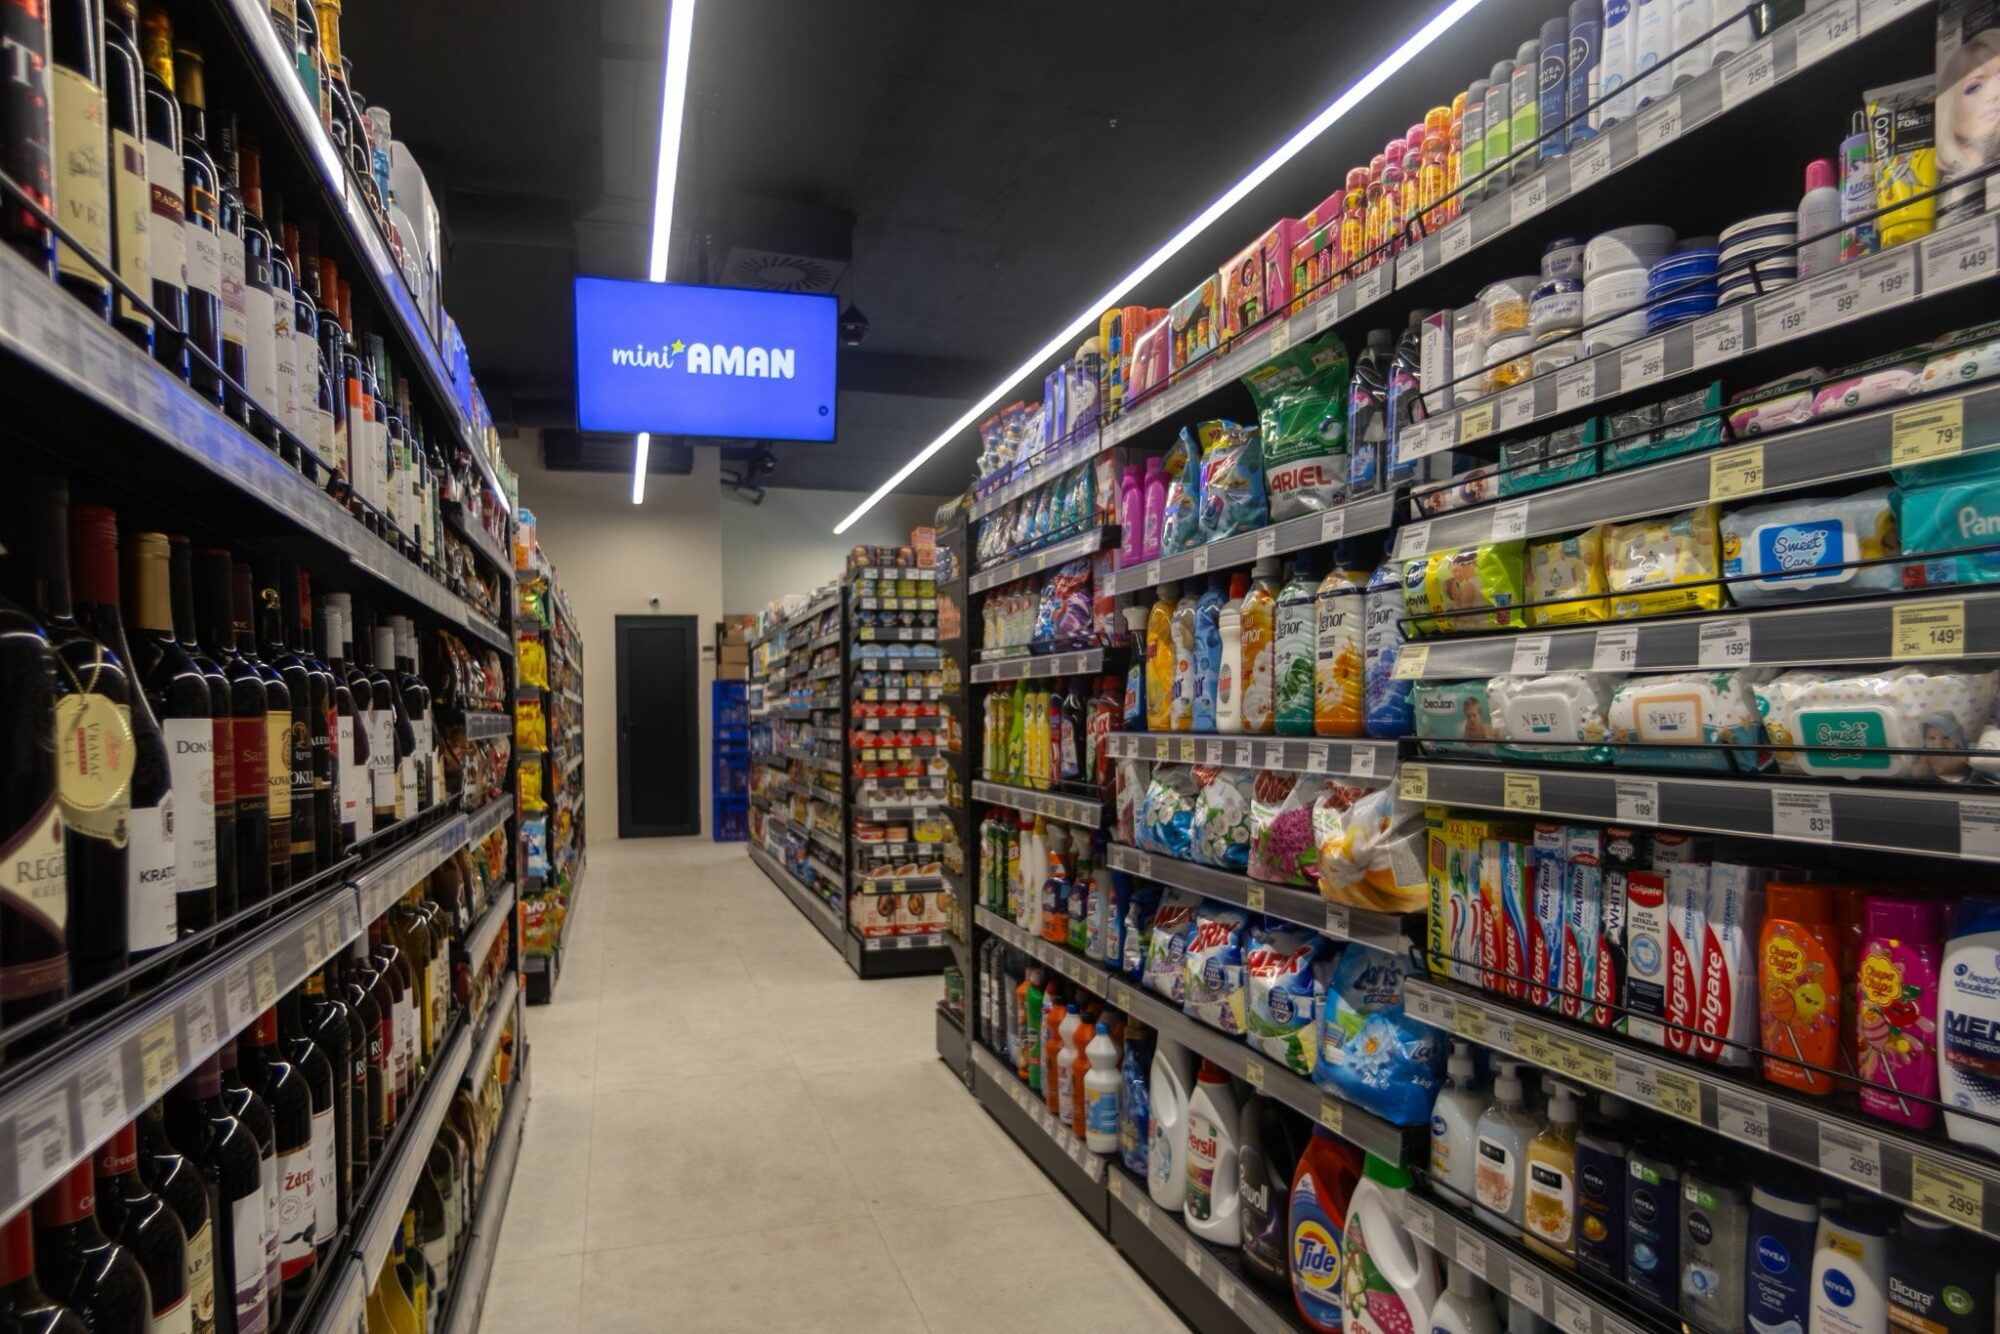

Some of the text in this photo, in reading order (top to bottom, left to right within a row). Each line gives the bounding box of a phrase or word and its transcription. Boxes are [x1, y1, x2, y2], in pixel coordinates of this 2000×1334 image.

[1826, 20, 1849, 42] 124
[1748, 65, 1768, 86] 259
[1659, 120, 1676, 138] 297
[1959, 250, 1988, 272] 449
[1879, 274, 1903, 294] 199
[1838, 295, 1853, 312] 99
[1780, 313, 1801, 331] 159
[1717, 336, 1737, 353] 429
[611, 342, 796, 380] mini AMAN
[1936, 427, 1954, 445] 79
[1271, 464, 1332, 495] ARIEL
[1743, 470, 1757, 485] 79
[1773, 536, 1823, 556] Sweet
[1781, 555, 1814, 570] Care
[1318, 611, 1347, 635] Lenor
[1366, 606, 1393, 630] Lenor
[1241, 626, 1263, 644] enor
[1277, 618, 1303, 641] Lenor
[1929, 629, 1955, 645] 149
[1619, 650, 1631, 662] 81
[1725, 642, 1744, 657] 159
[1534, 655, 1544, 667] 81
[1817, 724, 1866, 742] Sweet
[1525, 795, 1537, 806] 99
[1633, 803, 1650, 816] 109
[1809, 817, 1824, 832] 83
[1628, 882, 1663, 897] Colgate
[1609, 875, 1622, 930] WHITE
[1430, 875, 1444, 969] Kolynos
[1482, 909, 1497, 989] Colgate
[1769, 945, 1798, 960] Chupa
[1505, 925, 1520, 999] Colgate
[1531, 936, 1547, 1006] Colgate
[1768, 955, 1798, 970] Chups
[1563, 945, 1577, 1017] Colgate
[1865, 965, 1895, 981] Chupa
[1595, 951, 1610, 1025] Colgate
[1864, 977, 1895, 994] Chups
[1668, 950, 1688, 1049] Colgate
[1700, 951, 1722, 1054] Colgate
[1499, 1030, 1512, 1042] 112
[1636, 1080, 1652, 1096] 199
[1743, 1120, 1763, 1138] 299
[1850, 1158, 1873, 1177] 299
[1583, 1172, 1604, 1187] NIVEA
[1634, 1197, 1655, 1213] NIVEA
[1947, 1195, 1975, 1216] 299
[1688, 1219, 1712, 1236] NIVEA
[1297, 1238, 1337, 1274] Tide
[1758, 1246, 1786, 1263] NIVEA
[1757, 1281, 1786, 1300] Creme
[1823, 1280, 1853, 1298] NIVEA
[1888, 1276, 1932, 1306] Dicora
[1761, 1291, 1782, 1307] Care
